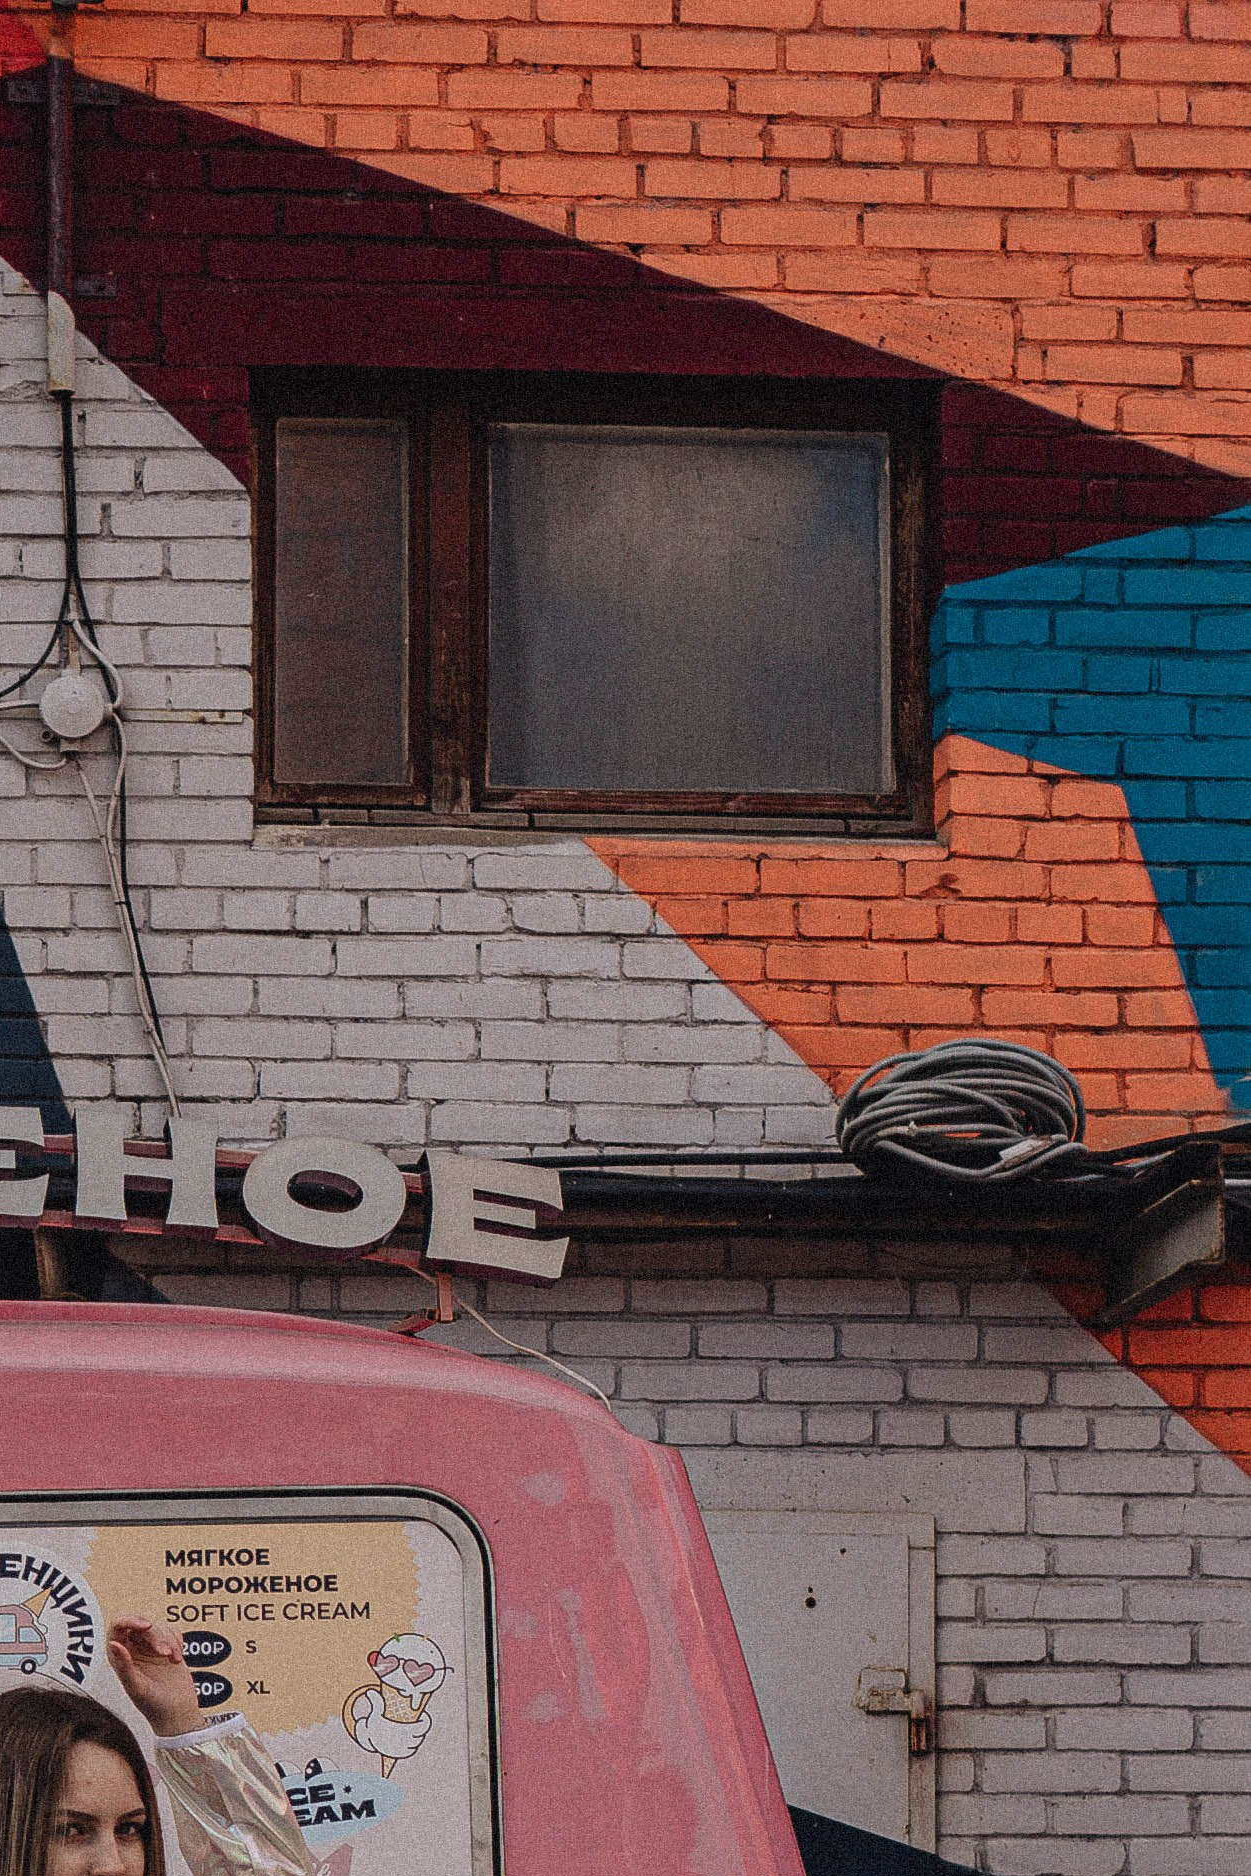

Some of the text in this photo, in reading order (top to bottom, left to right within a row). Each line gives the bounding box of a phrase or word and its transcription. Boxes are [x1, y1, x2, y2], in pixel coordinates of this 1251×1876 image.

[165, 1548, 270, 1567] МЯГКОЕ
[166, 1574, 339, 1595] МОРОЖЕНОЕ
[166, 1601, 371, 1623] SOFT ICE CREAM
[245, 1640, 257, 1654] S
[246, 1680, 271, 1695] XL
[286, 1783, 336, 1806] CE
[293, 1799, 377, 1828] EAM
